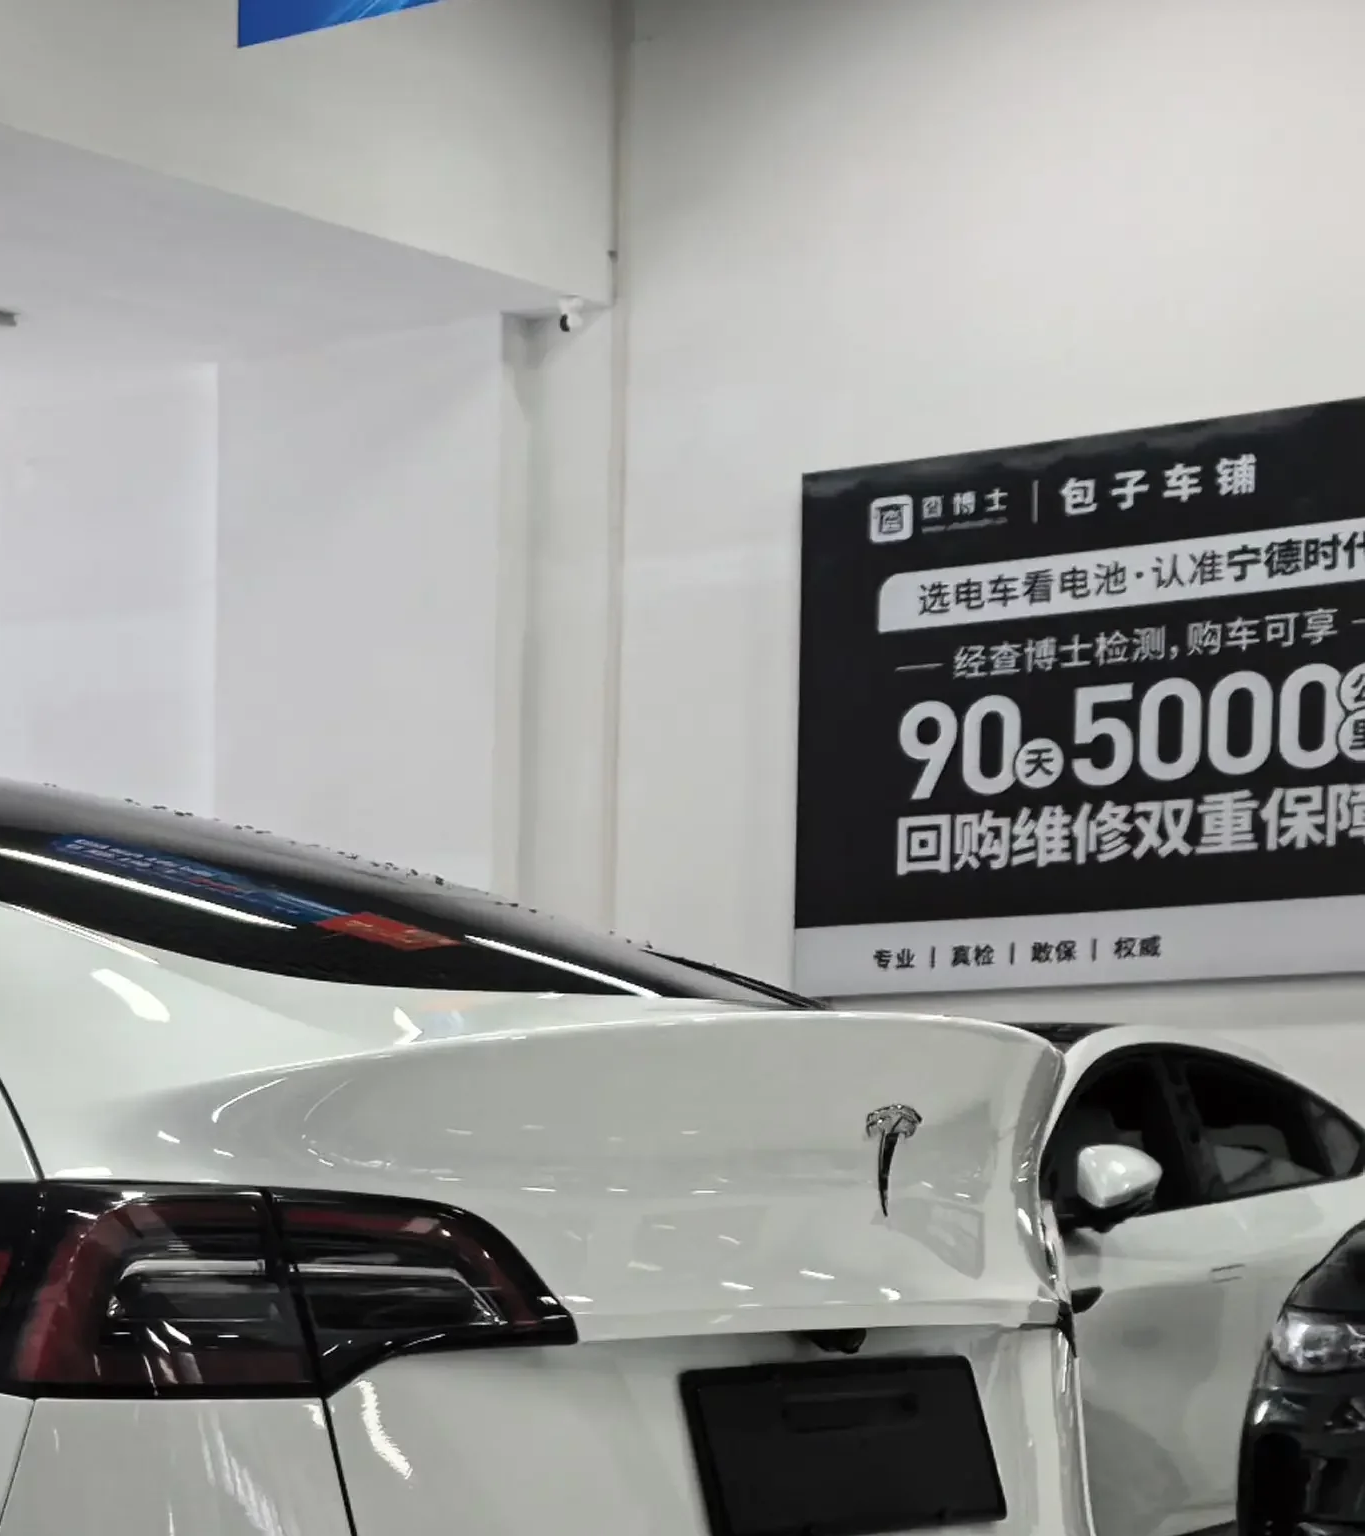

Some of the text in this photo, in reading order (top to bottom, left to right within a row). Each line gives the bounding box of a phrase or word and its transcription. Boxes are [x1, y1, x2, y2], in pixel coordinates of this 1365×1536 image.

[1060, 454, 1257, 516] 包子车铺
[873, 948, 915, 970] 专业
